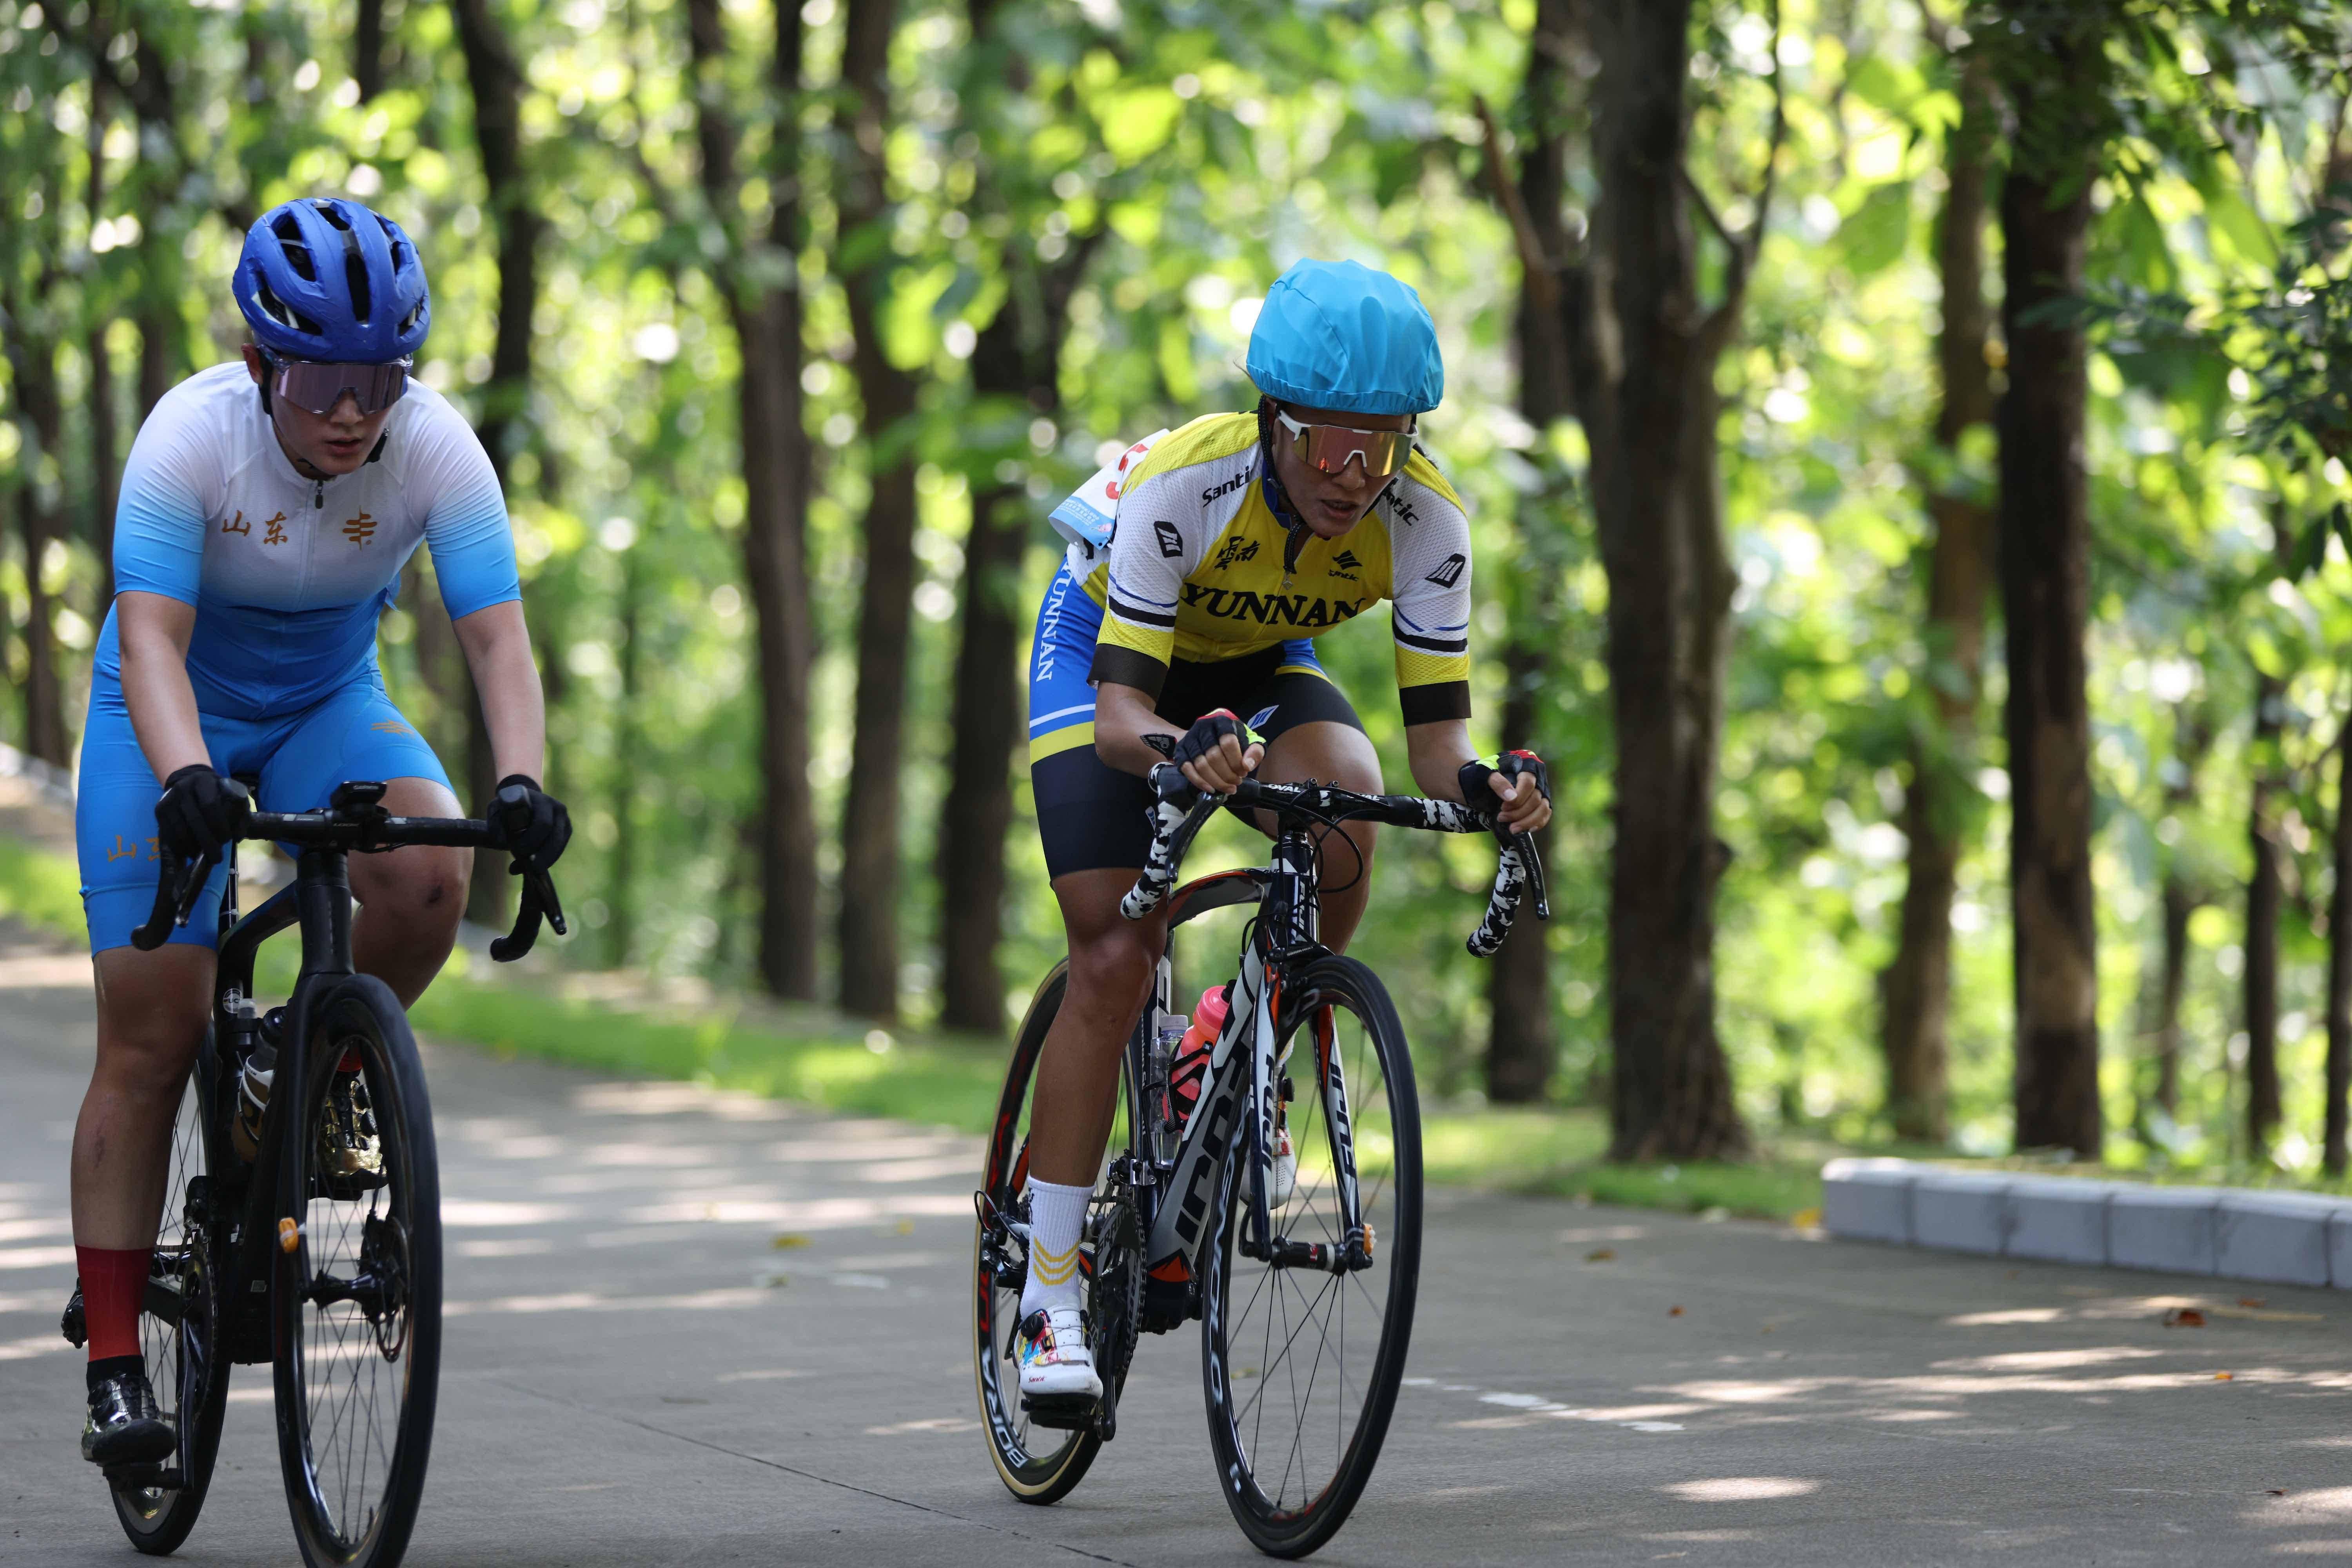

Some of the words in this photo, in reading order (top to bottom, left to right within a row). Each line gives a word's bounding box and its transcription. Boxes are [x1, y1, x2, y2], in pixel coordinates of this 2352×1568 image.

[1203, 465, 1254, 508] Santi
[221, 510, 288, 546] 山东
[1036, 561, 1073, 682] YUNNAN
[1180, 583, 1367, 627] YUNNAN
[981, 1344, 1028, 1468] BORA
